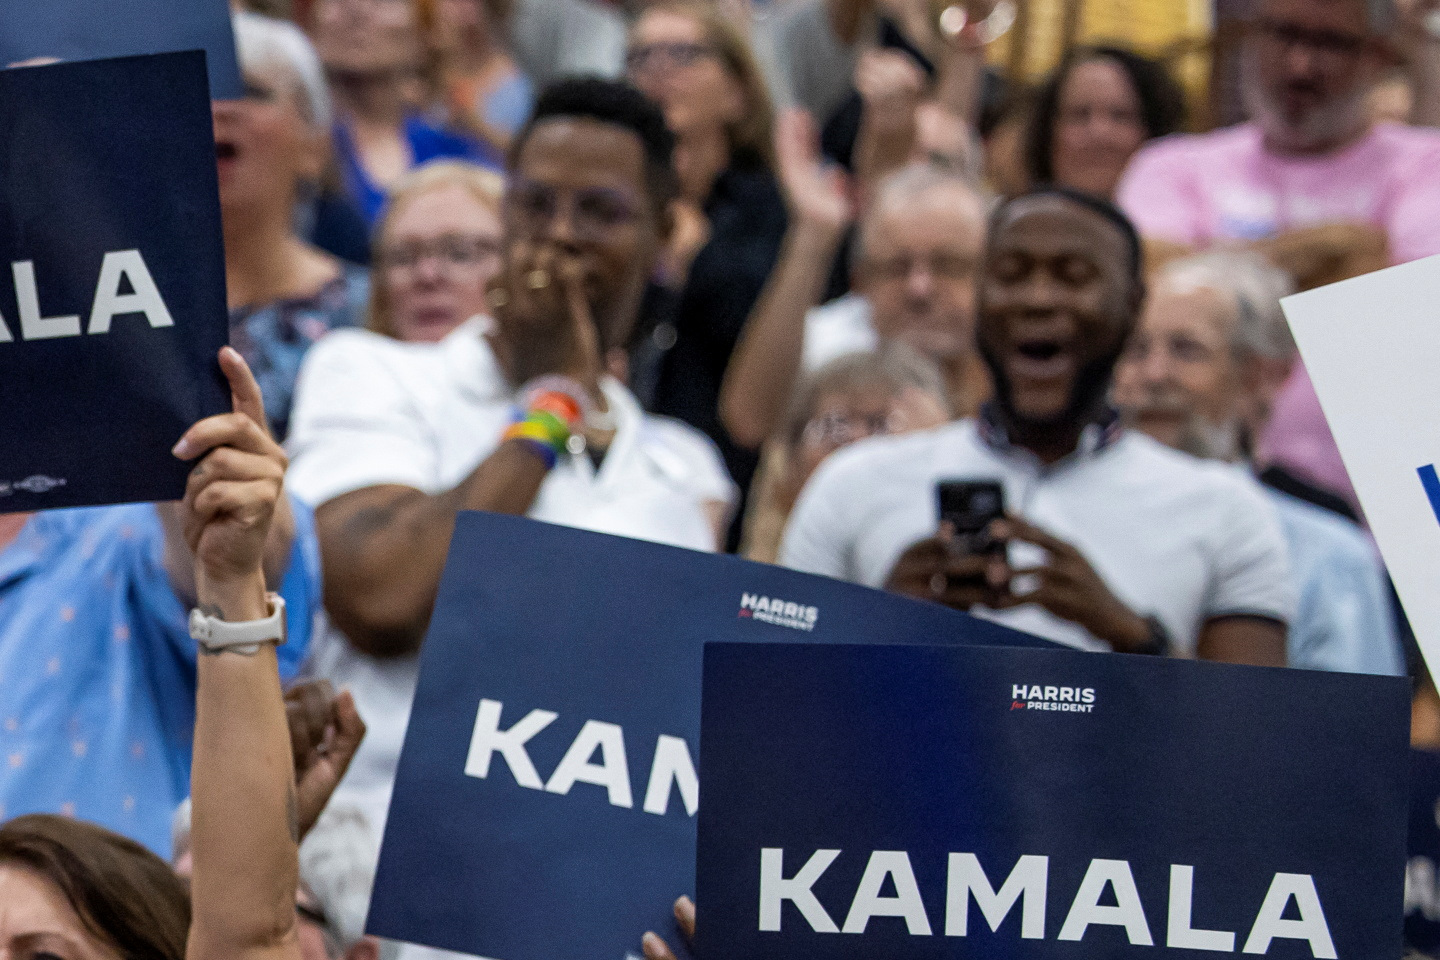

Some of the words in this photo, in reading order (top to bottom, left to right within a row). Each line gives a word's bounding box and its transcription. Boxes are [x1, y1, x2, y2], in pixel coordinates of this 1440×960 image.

[740, 592, 819, 623] HARRIS
[1010, 700, 1026, 711] for
[1027, 701, 1095, 713] PRESIDENT
[1012, 684, 1095, 703] HARRIS
[464, 698, 699, 817] KAM
[758, 847, 1339, 960] KAMALA
